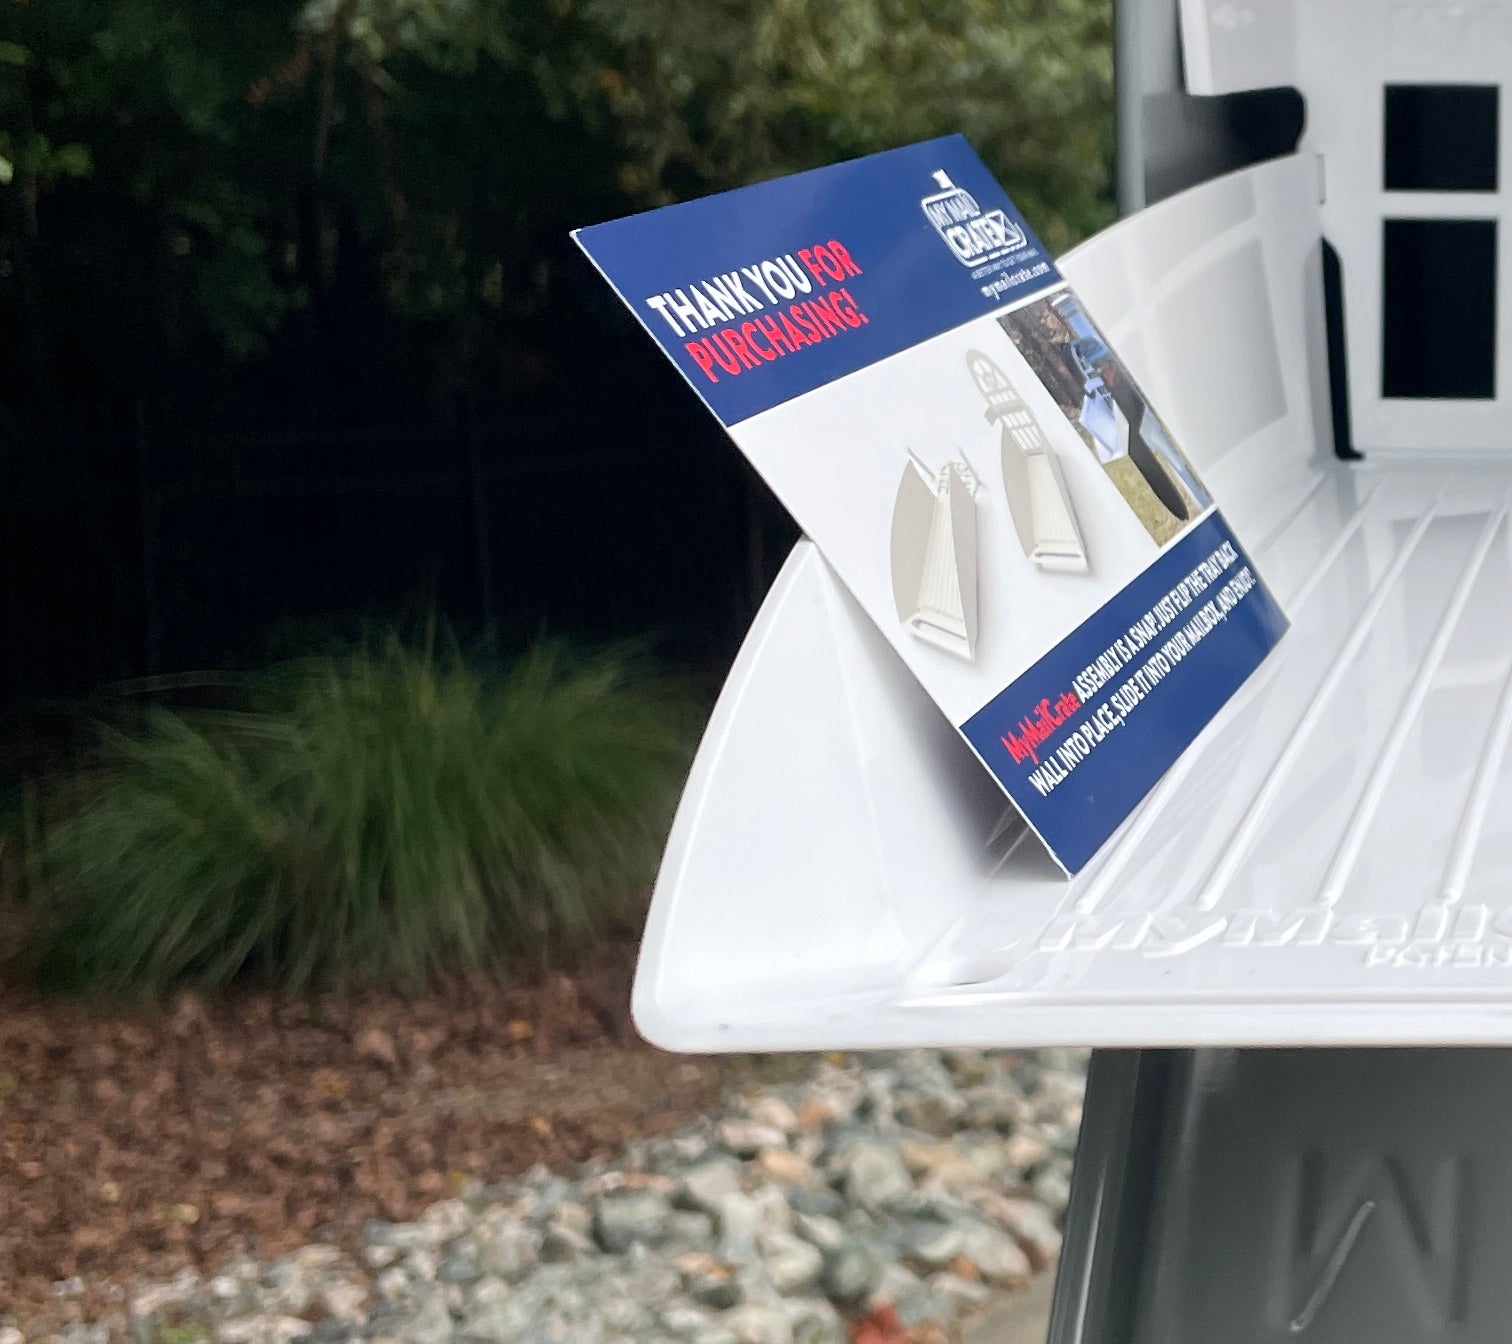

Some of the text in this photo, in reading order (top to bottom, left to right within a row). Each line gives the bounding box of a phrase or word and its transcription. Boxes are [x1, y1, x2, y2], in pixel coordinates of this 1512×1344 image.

[947, 214, 1003, 259] CRATE
[646, 239, 863, 337] THANK YOU FOR
[684, 287, 870, 384] PURCHASING!
[1184, 567, 1208, 596] THE
[1197, 554, 1222, 584] TRAY
[1153, 595, 1178, 627] JUST
[1169, 582, 1192, 611] FLIP
[1216, 586, 1237, 614] AND
[1129, 611, 1162, 648] SNAP!
[1183, 600, 1227, 646] MAILBOX,
[1114, 639, 1133, 662] IS
[1124, 632, 1140, 655] A
[1161, 631, 1192, 665] YOUR
[1072, 647, 1123, 703] ASSEMBLY
[1134, 670, 1152, 694] IT
[1142, 653, 1170, 685] INTO
[1111, 678, 1145, 717] SLIDE
[1080, 703, 1125, 747] PLACE,
[1056, 732, 1090, 771] INTO
[1028, 756, 1068, 796] WALL
